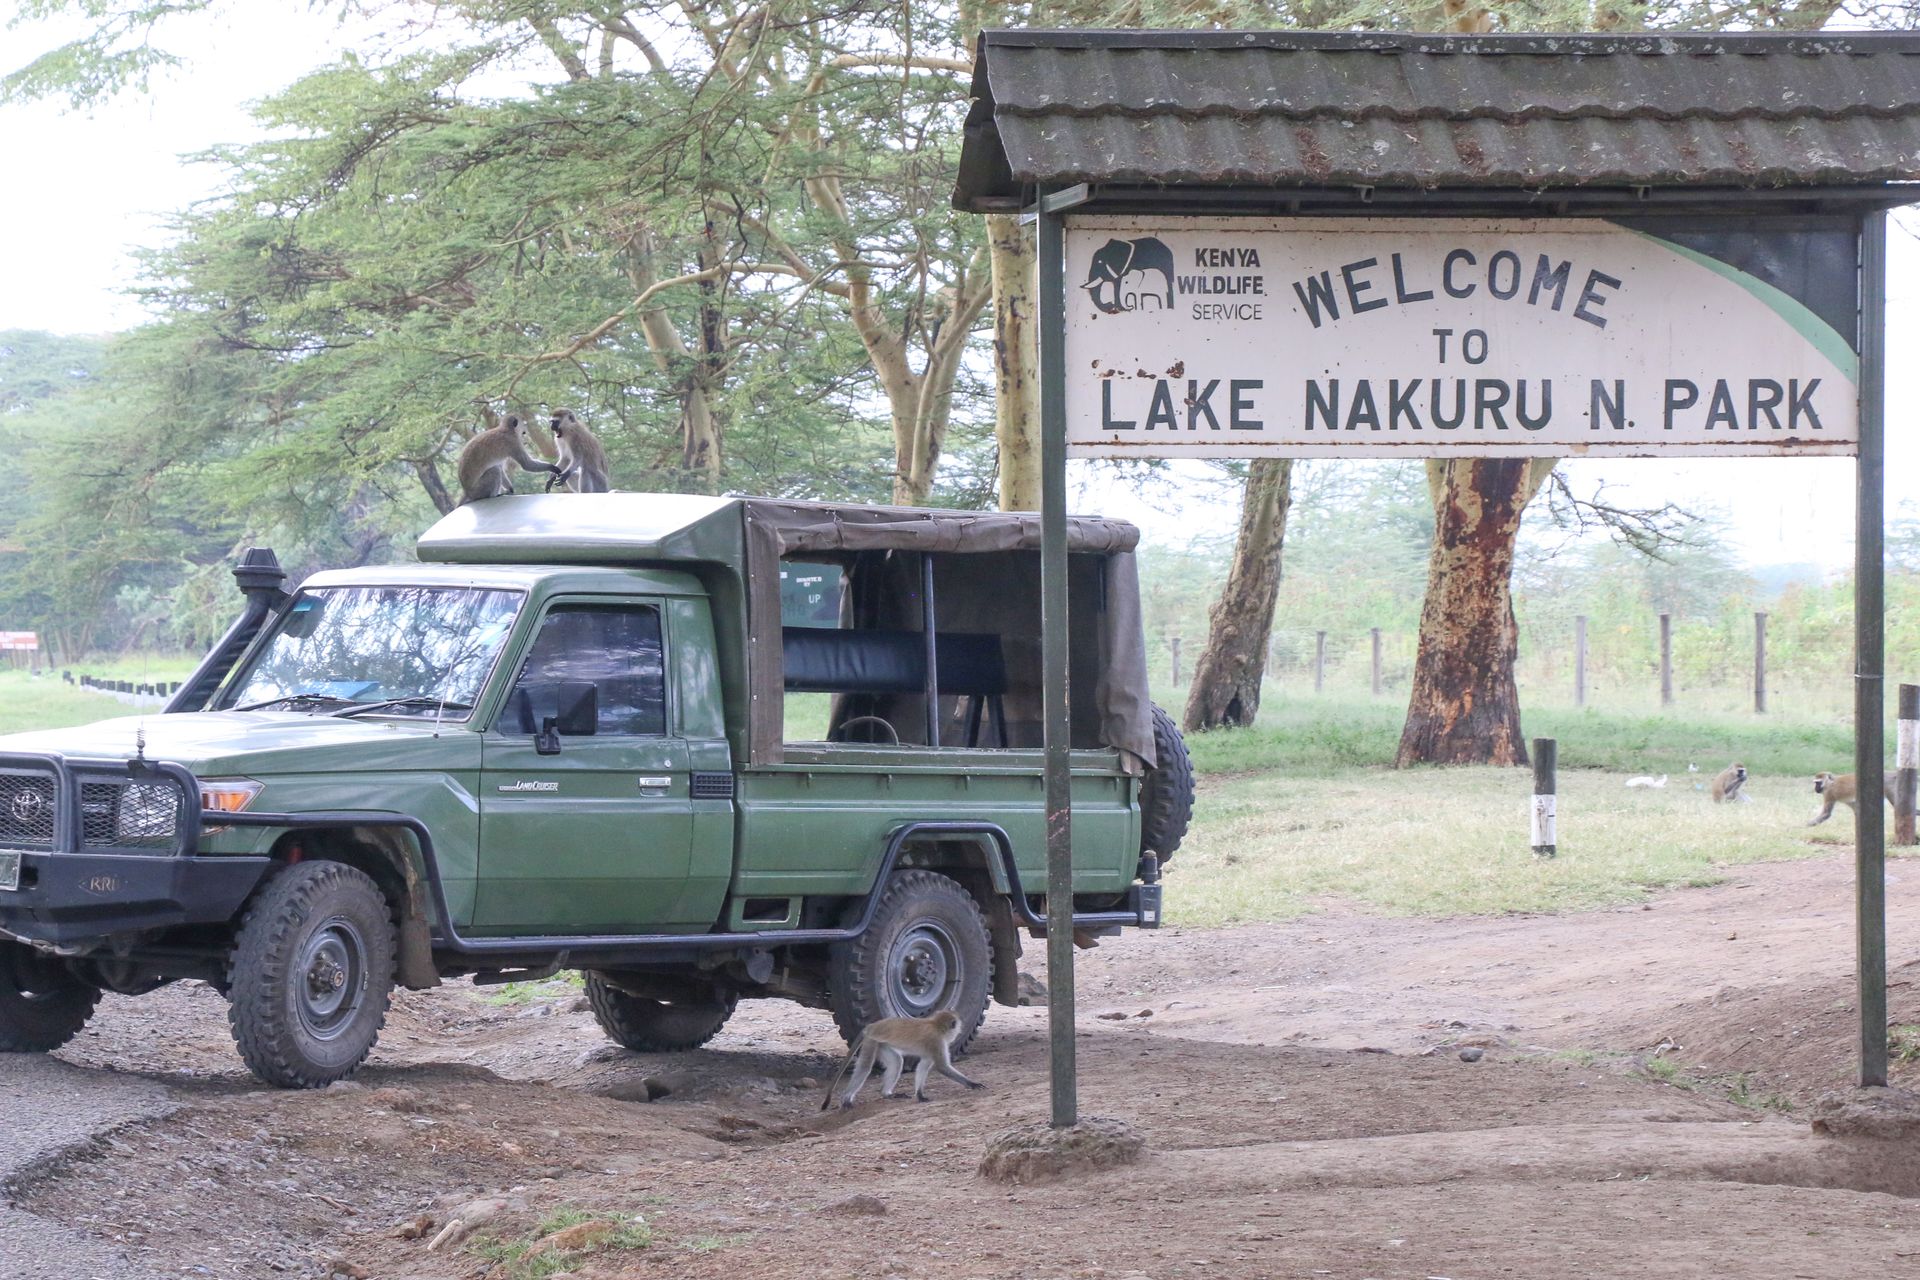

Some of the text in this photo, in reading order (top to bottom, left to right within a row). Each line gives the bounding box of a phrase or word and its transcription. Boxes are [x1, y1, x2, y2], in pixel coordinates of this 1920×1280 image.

[1195, 247, 1261, 268] KENYA
[1177, 275, 1264, 295] WILDLIFE
[1291, 247, 1622, 330] WELCOME
[1192, 303, 1263, 321] SERVICE
[1432, 328, 1488, 365] TO
[1102, 378, 1823, 431] LAKE NAKURU N. PARK
